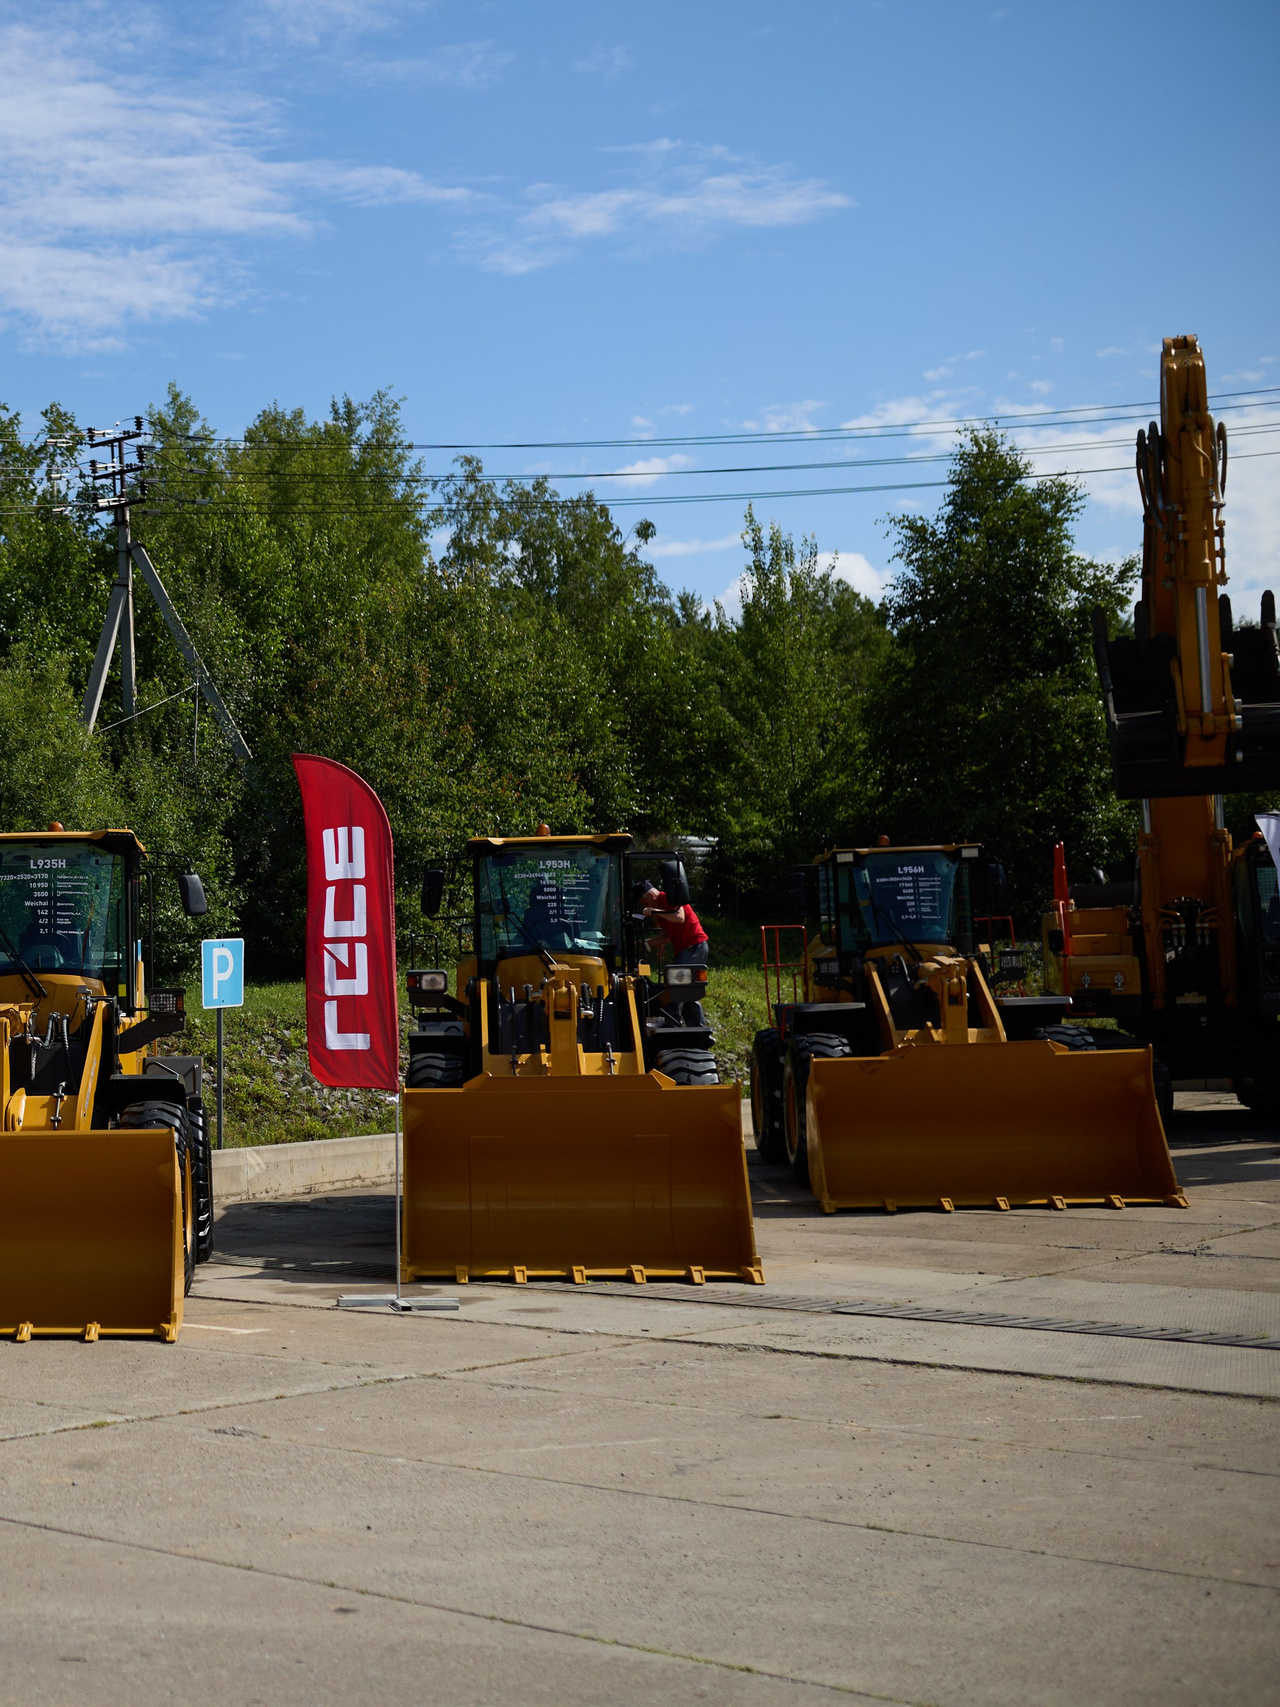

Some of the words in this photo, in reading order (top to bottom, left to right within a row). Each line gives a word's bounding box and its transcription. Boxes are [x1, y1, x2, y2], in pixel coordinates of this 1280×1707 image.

[30, 859, 66, 869] L935H
[540, 860, 570, 869] L953H
[898, 866, 924, 874] L956H
[322, 826, 370, 1050] LGCE
[213, 948, 234, 999] P
